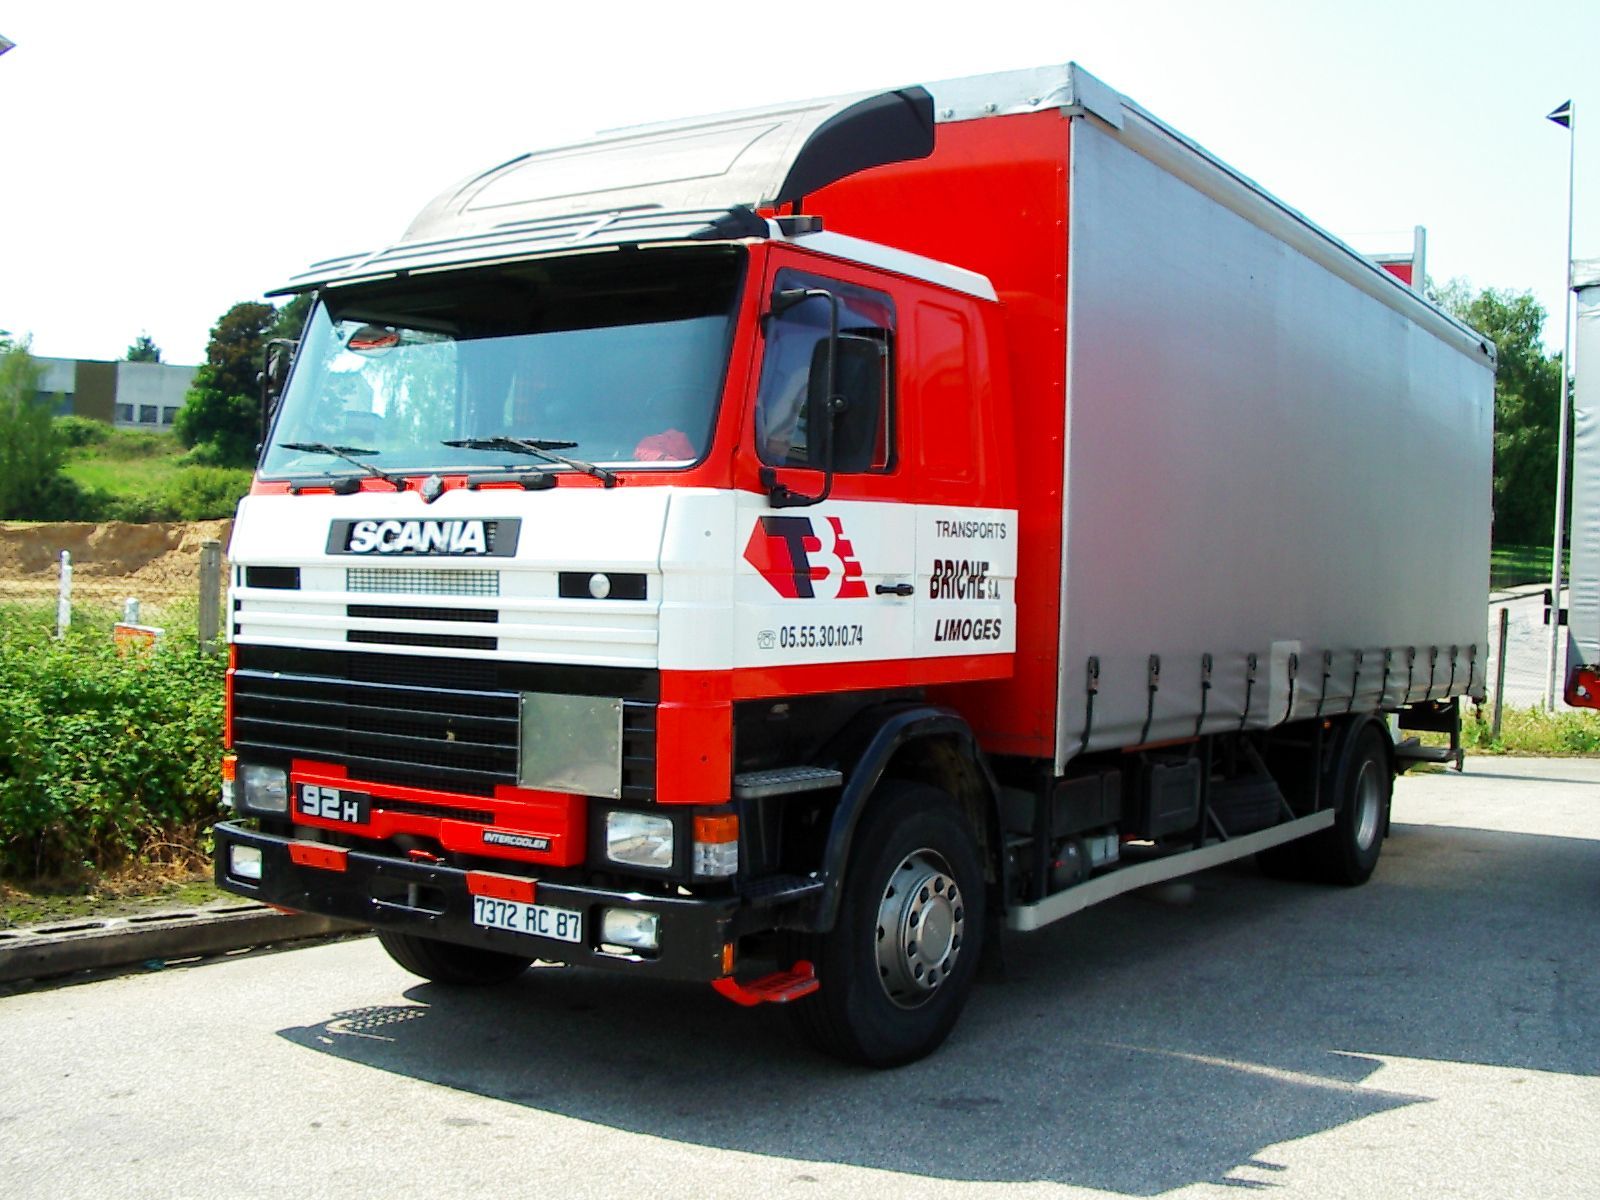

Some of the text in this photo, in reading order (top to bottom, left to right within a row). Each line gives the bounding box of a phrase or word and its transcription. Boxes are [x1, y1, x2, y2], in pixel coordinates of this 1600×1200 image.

[349, 519, 488, 554] SCANIA
[935, 520, 1007, 540] TRANSPORTS
[929, 559, 989, 600] BRICHE
[780, 624, 864, 648] 05.55.30.10.74
[934, 618, 1002, 642] LIMOGES
[483, 832, 549, 850] INTERCOOLER
[476, 898, 580, 939] 7372 RC 87
